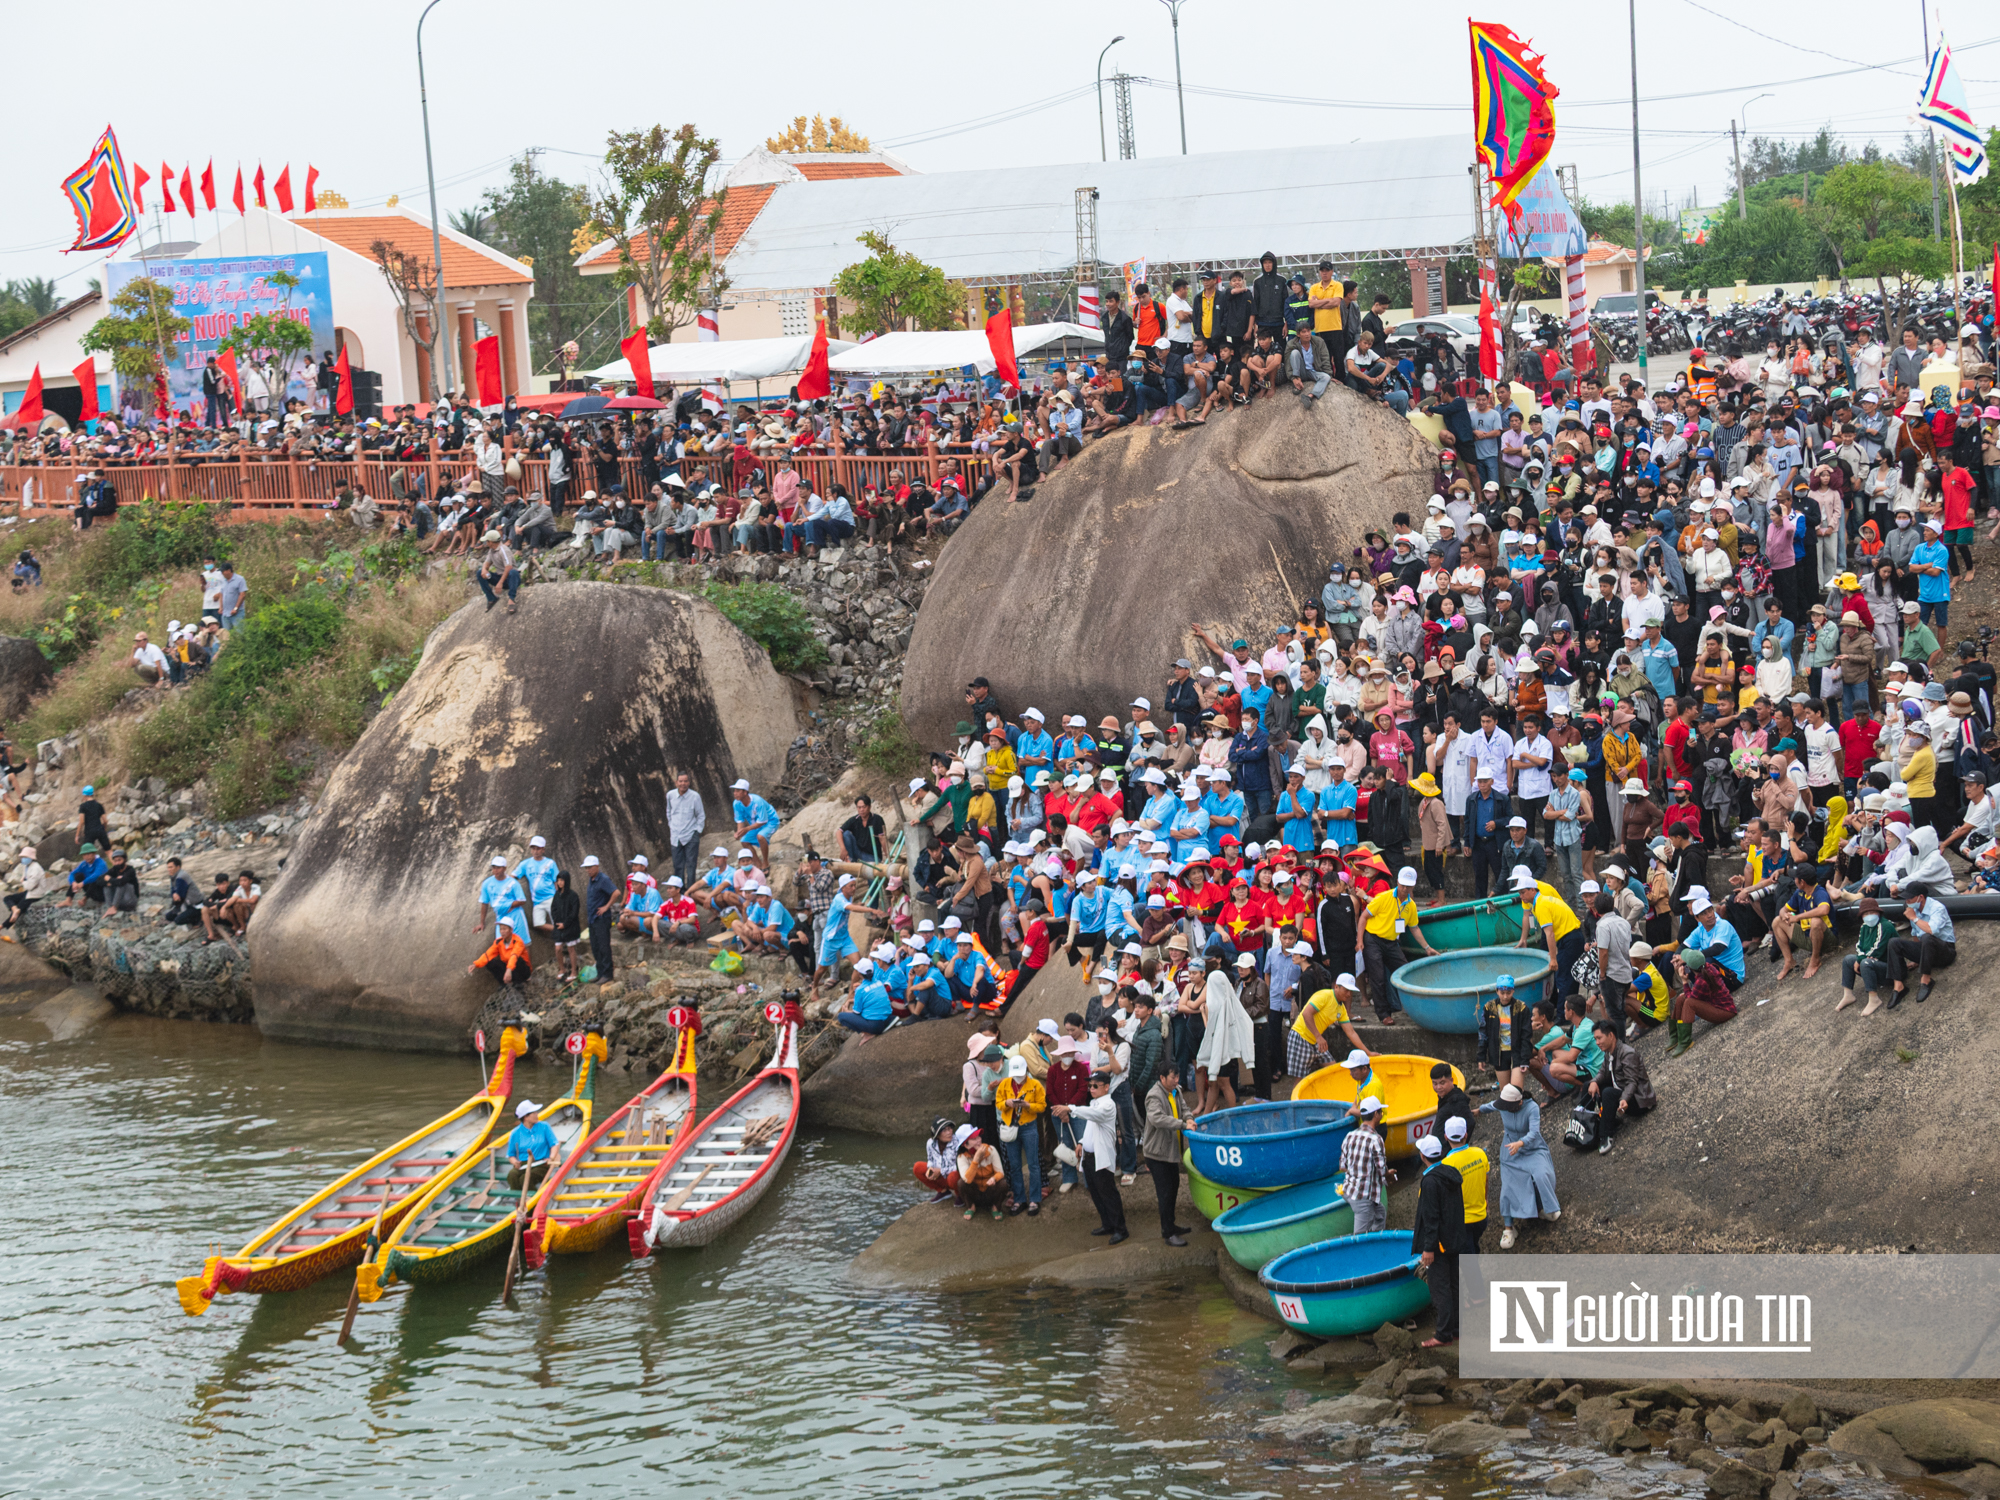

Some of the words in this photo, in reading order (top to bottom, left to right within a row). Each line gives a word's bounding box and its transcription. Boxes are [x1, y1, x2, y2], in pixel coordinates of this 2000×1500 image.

[672, 1009, 681, 1026] 1
[768, 1004, 780, 1022] 2
[570, 1035, 583, 1051] 3
[1413, 1120, 1434, 1140] 07
[1215, 1145, 1243, 1168] 08
[1214, 1193, 1240, 1211] 12
[1280, 1301, 1301, 1319] 01
